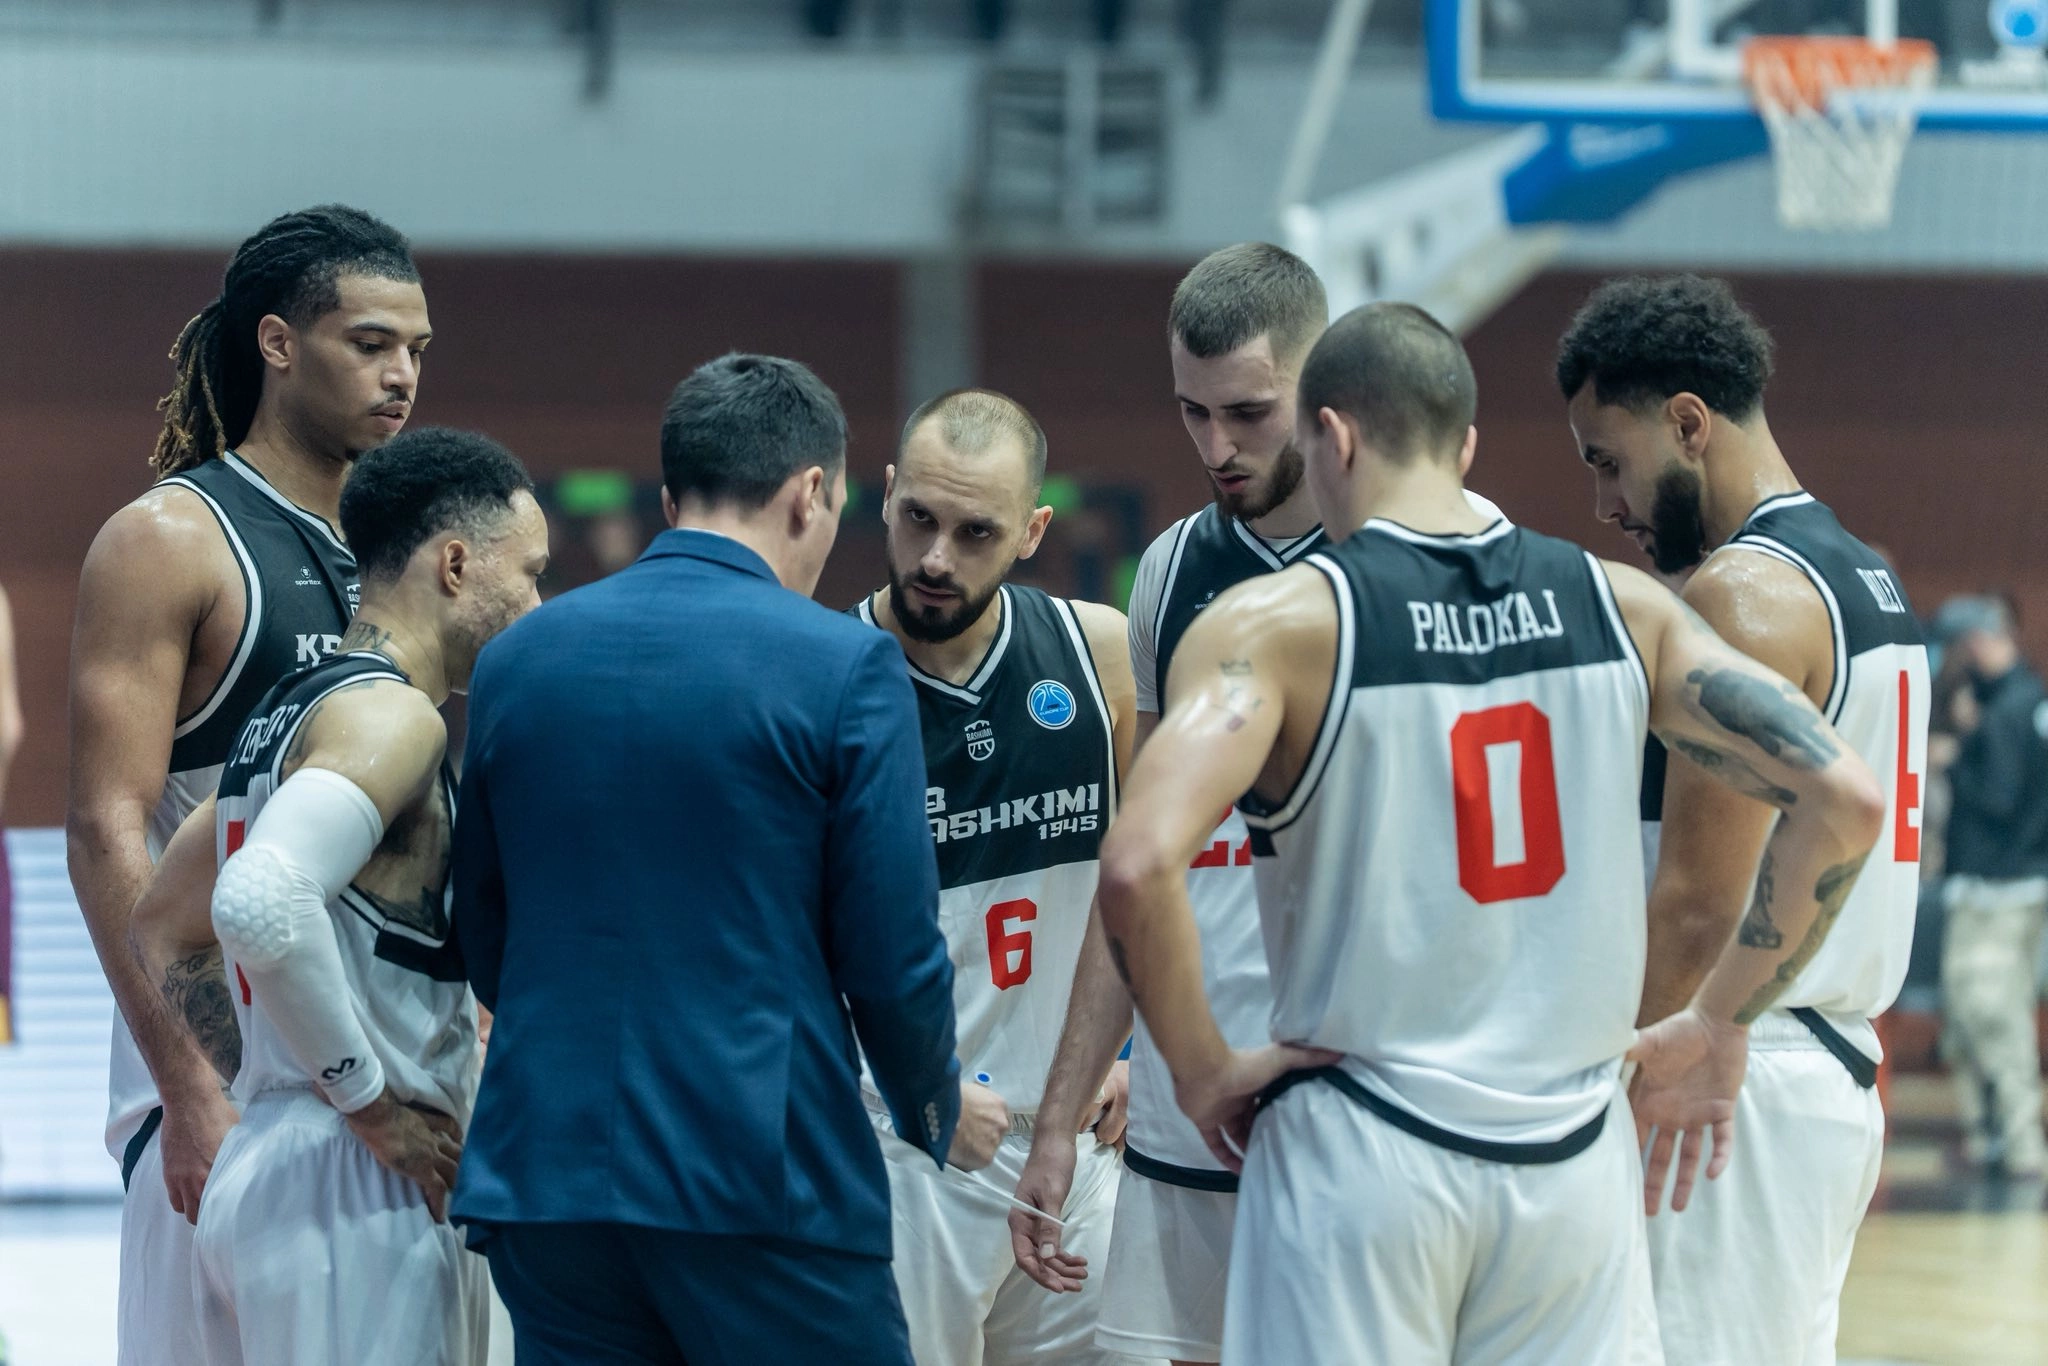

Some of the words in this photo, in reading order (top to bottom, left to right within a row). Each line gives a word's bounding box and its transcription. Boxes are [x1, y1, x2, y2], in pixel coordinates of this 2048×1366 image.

[1406, 588, 1565, 655] PALOKAJ
[928, 783, 1099, 844] ASHKIMI
[1038, 815, 1098, 841] 1945
[1450, 700, 1567, 905] 0
[985, 897, 1038, 992] 6
